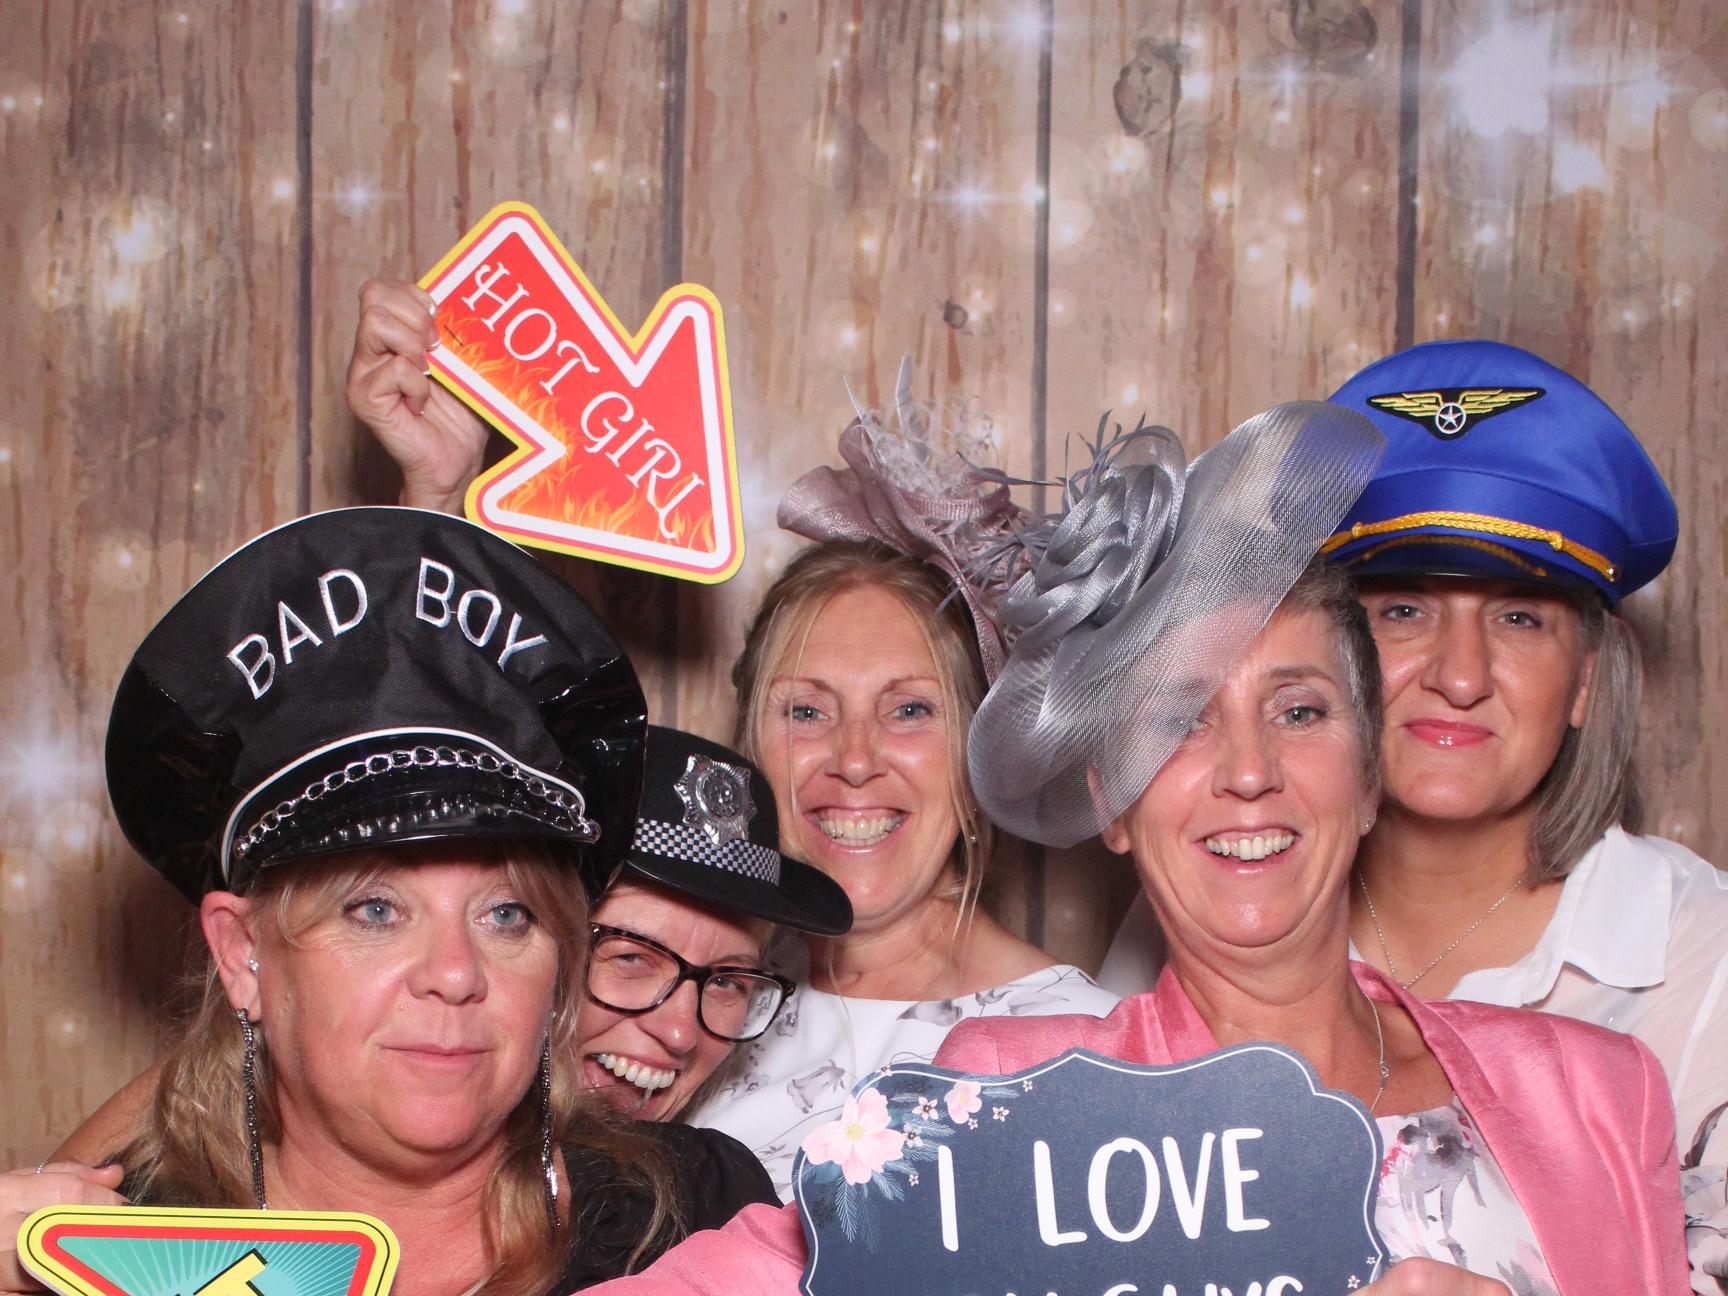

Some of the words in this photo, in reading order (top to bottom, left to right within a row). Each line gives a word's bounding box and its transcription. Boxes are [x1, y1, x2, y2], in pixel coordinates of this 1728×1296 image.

[461, 261, 600, 396] HOT
[580, 391, 705, 540] GIRL
[226, 568, 368, 700] BAD
[416, 556, 549, 672] BOY
[938, 1144, 960, 1252] I
[1033, 1127, 1271, 1247] LOVE
